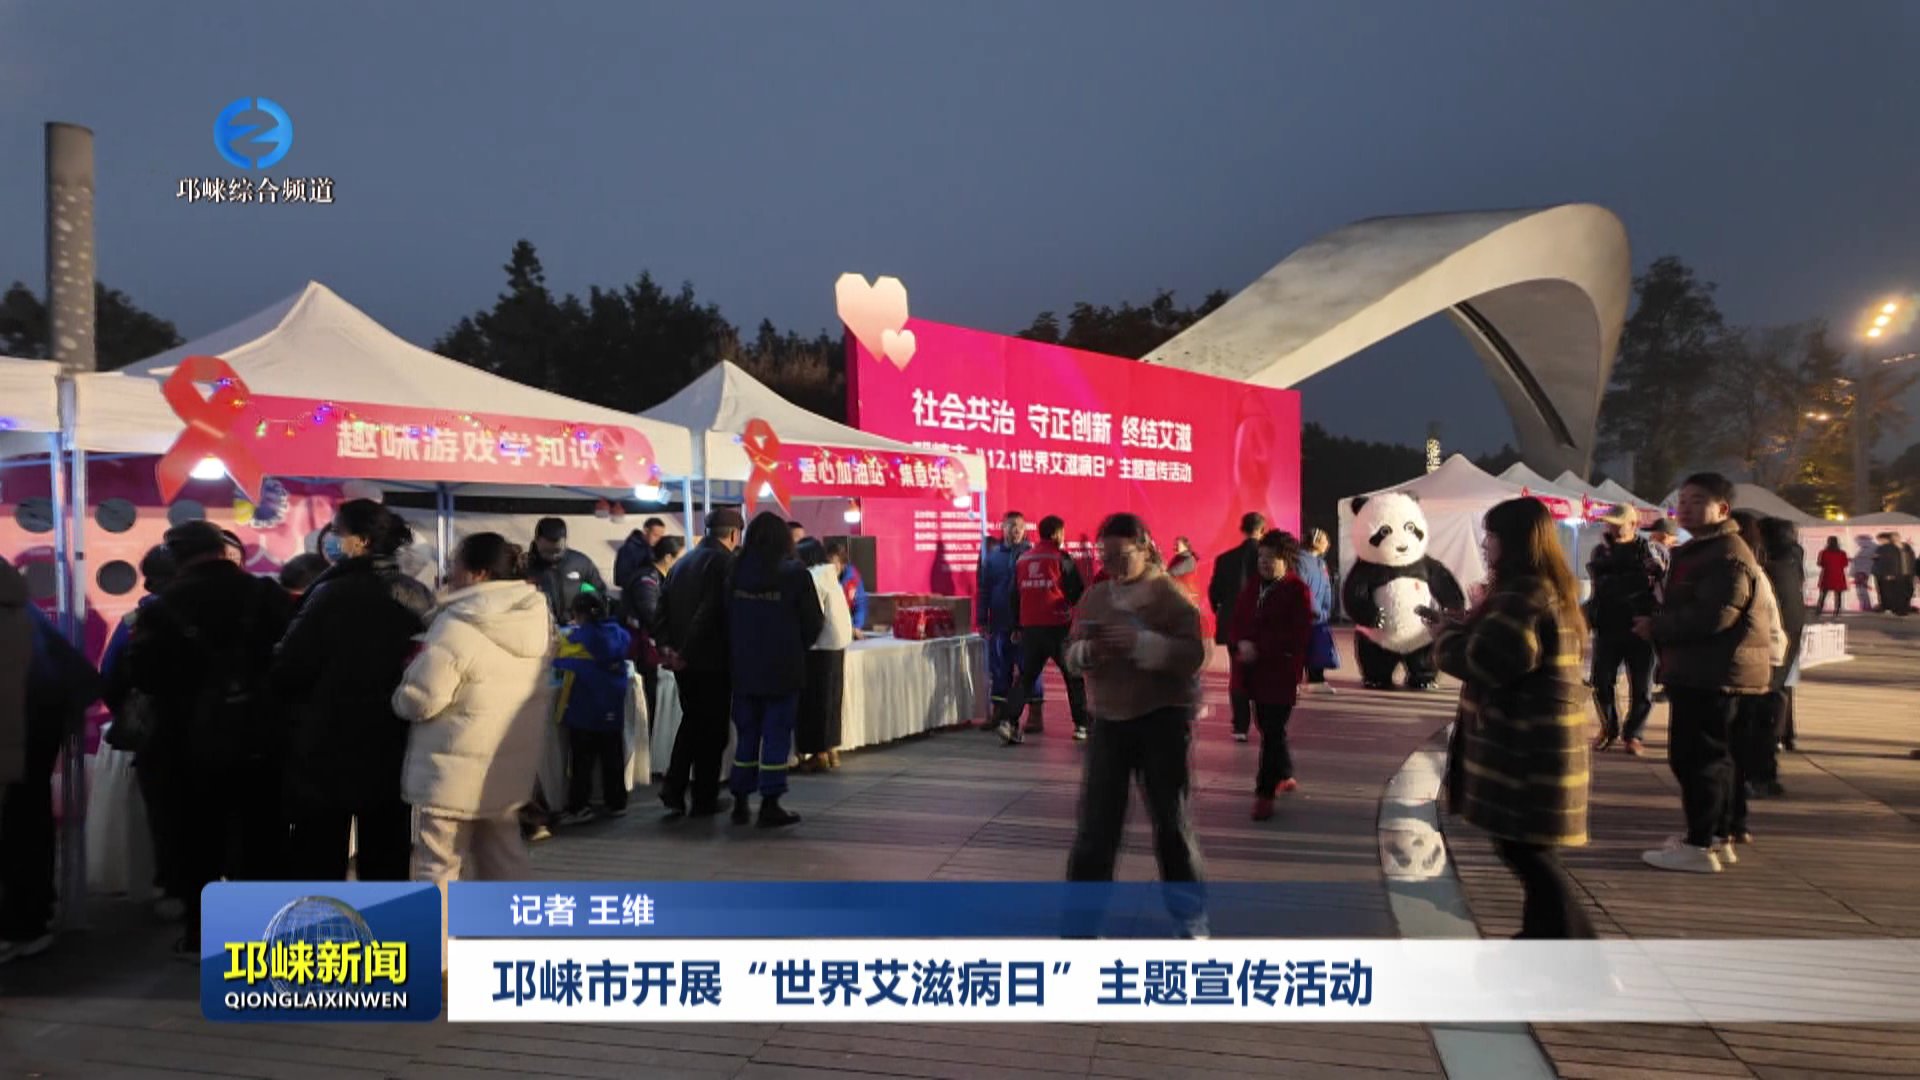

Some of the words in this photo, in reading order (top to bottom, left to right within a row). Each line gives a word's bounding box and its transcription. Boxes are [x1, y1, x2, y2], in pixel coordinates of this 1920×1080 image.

[337, 421, 601, 469] 趣味游戏学知识
[912, 388, 1015, 434] 社会共治
[1027, 404, 1112, 444] 守正创新
[1121, 415, 1193, 452] 终结艾滋
